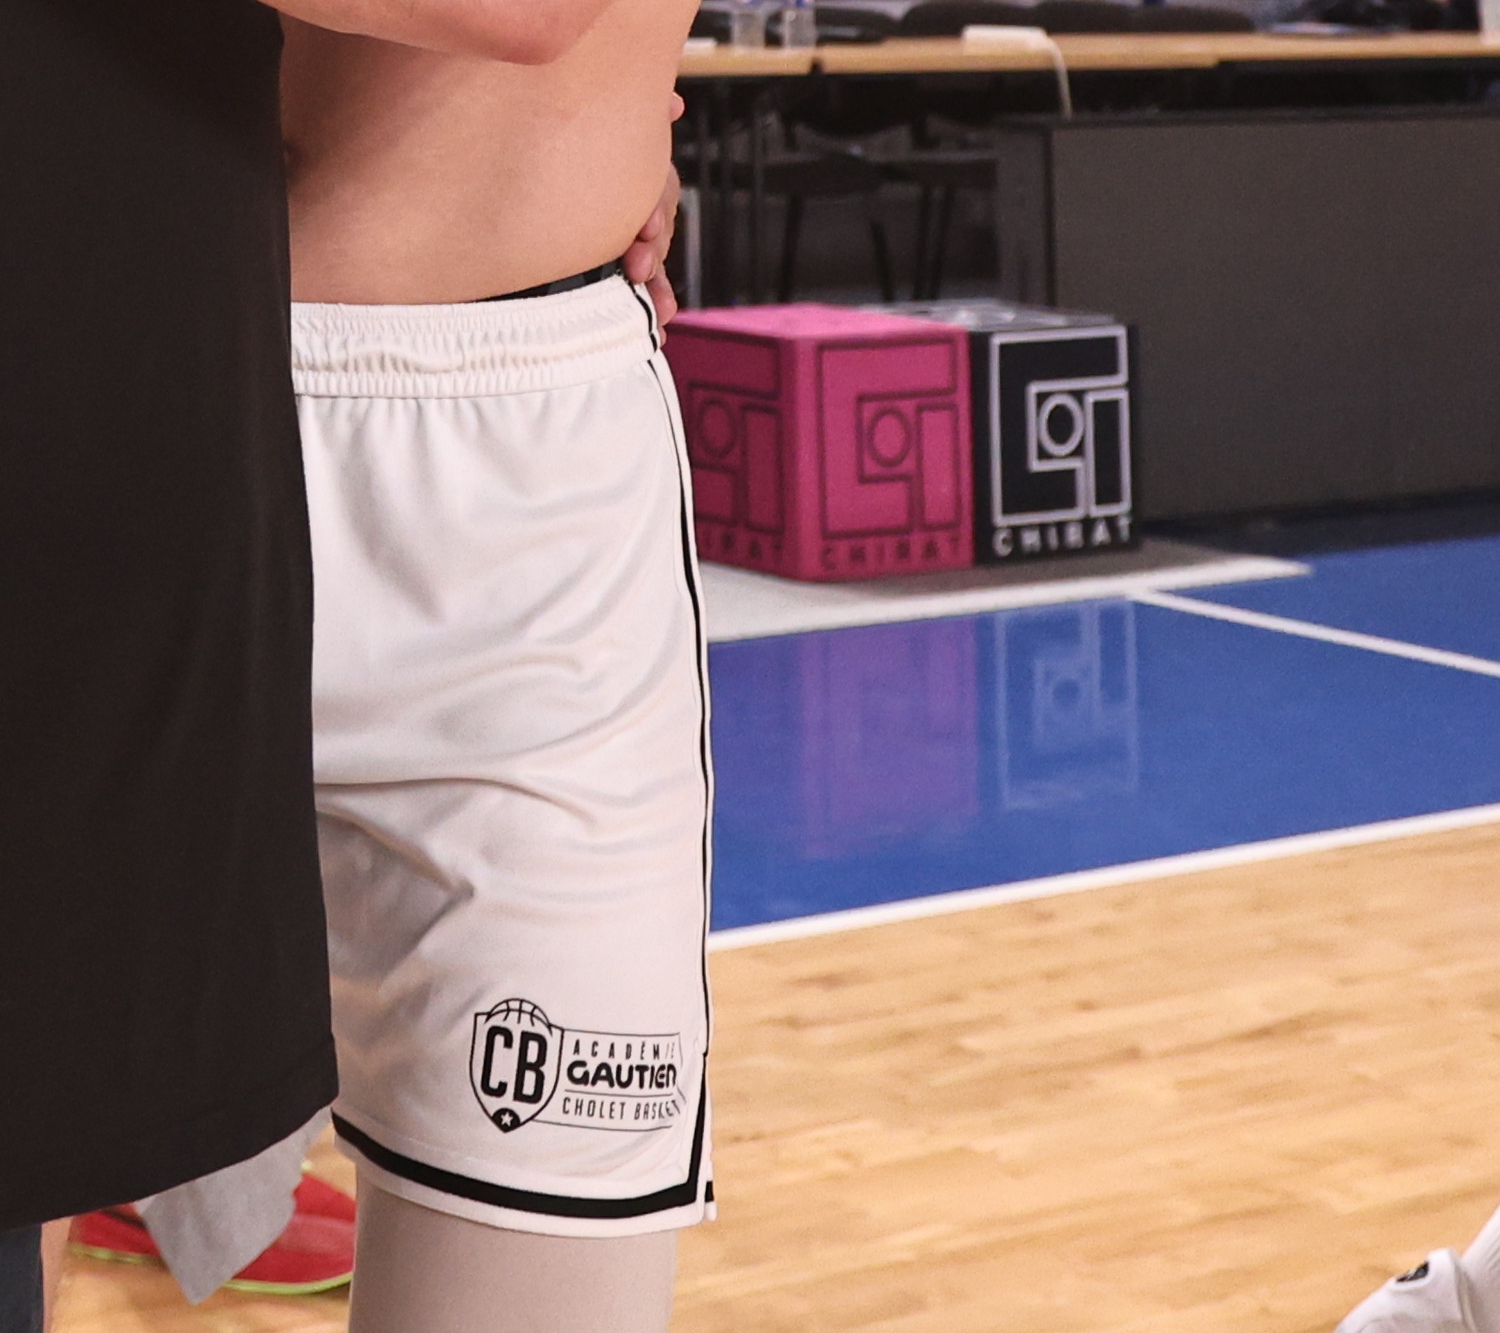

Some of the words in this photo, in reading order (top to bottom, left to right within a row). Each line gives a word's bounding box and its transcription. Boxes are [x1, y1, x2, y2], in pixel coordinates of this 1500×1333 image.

[702, 529, 784, 560] IRAT
[993, 516, 1133, 556] CHIRAT
[820, 536, 962, 570] CHIRAT
[480, 1025, 549, 1106] CB
[566, 1059, 678, 1091] GAUTIER
[562, 1097, 627, 1121] CHOLET
[633, 1098, 683, 1121] BASKET
